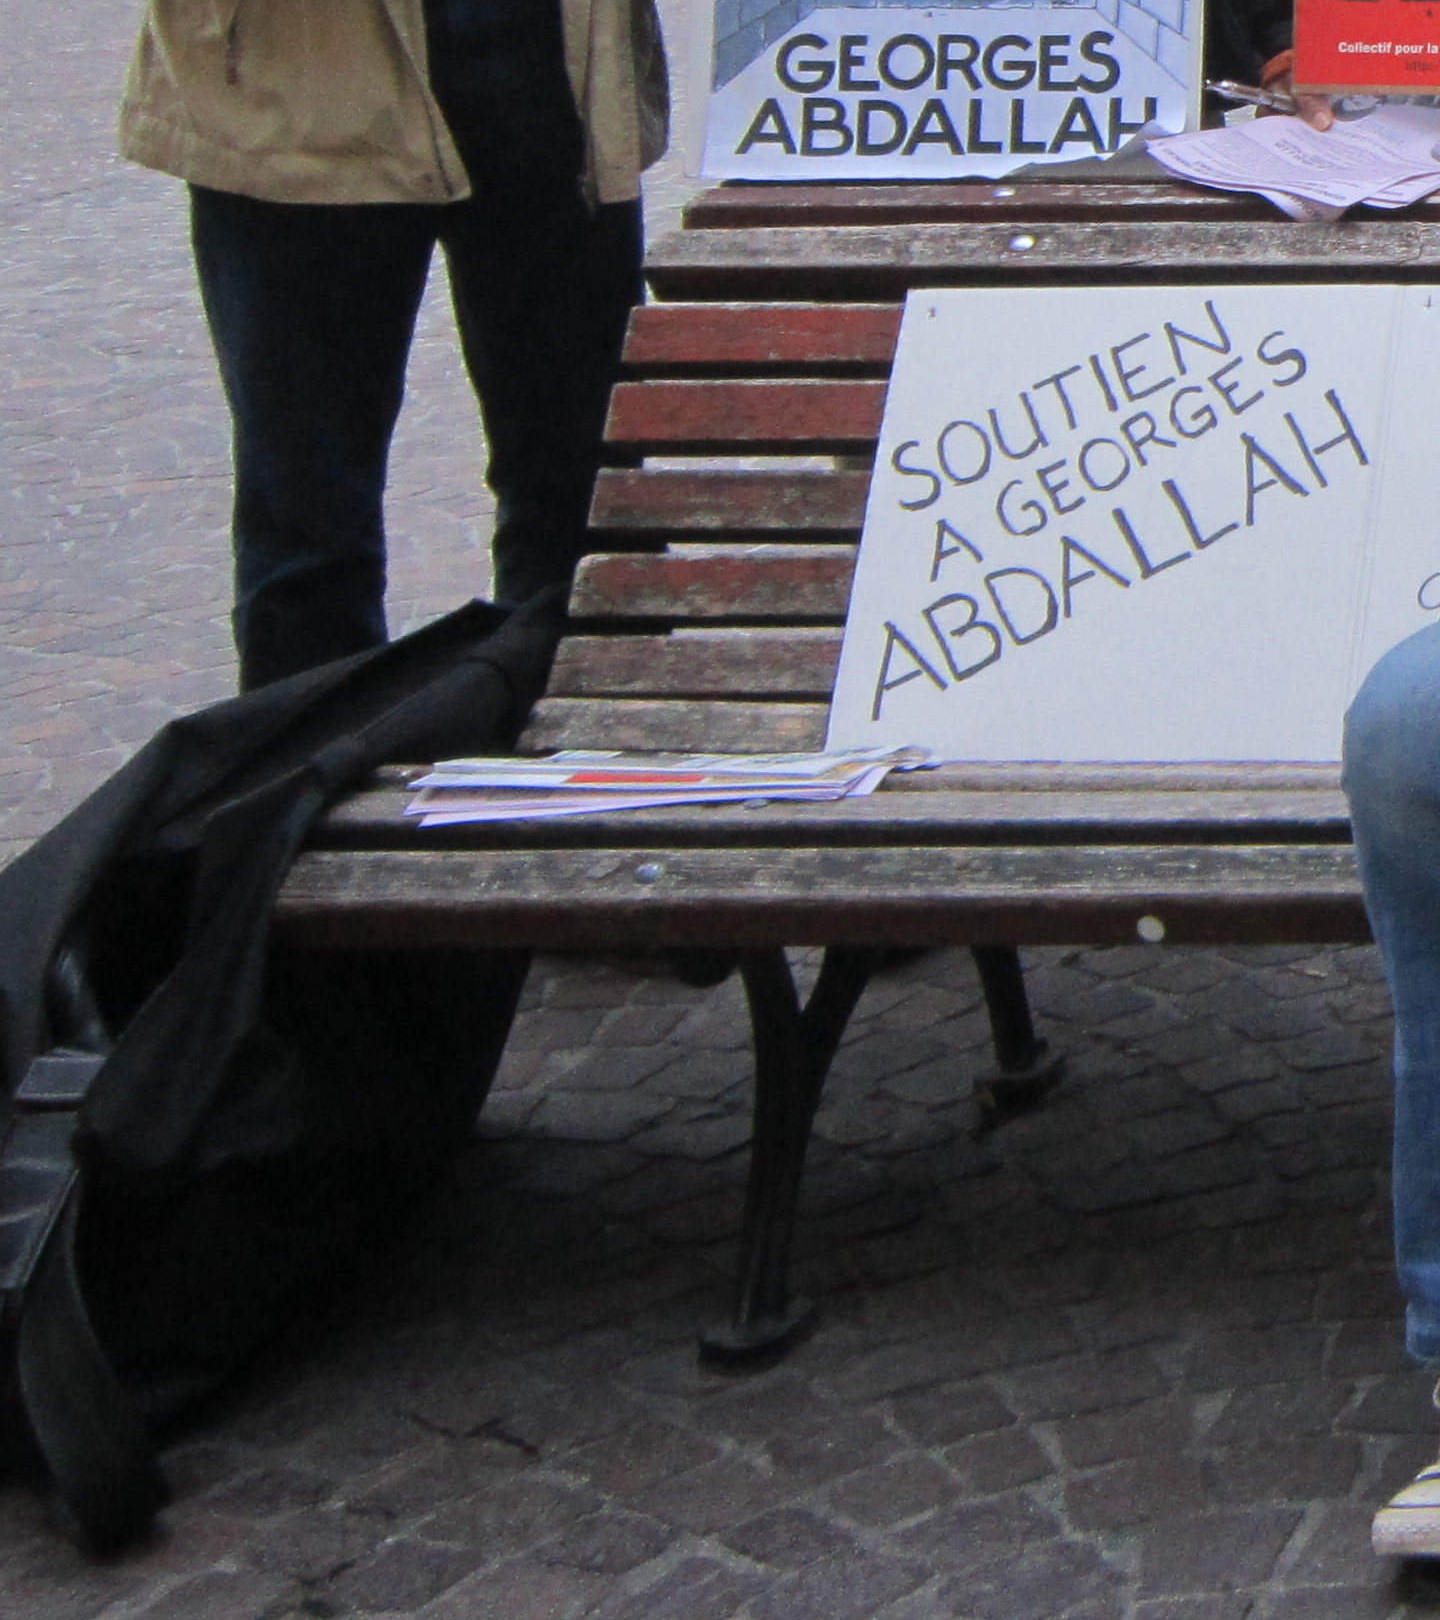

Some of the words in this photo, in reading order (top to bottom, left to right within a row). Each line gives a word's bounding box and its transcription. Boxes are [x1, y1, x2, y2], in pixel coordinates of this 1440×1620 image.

[775, 29, 1121, 95] GEORGES
[1337, 41, 1392, 55] Collectif
[1395, 43, 1424, 57] pour
[1426, 41, 1440, 55] la
[735, 96, 1158, 157] ABDALLAH
[891, 300, 1232, 512] SOUTIEN
[929, 518, 984, 583] A
[995, 331, 1308, 538] GEORGES
[871, 388, 1370, 722] ABDALLAH
